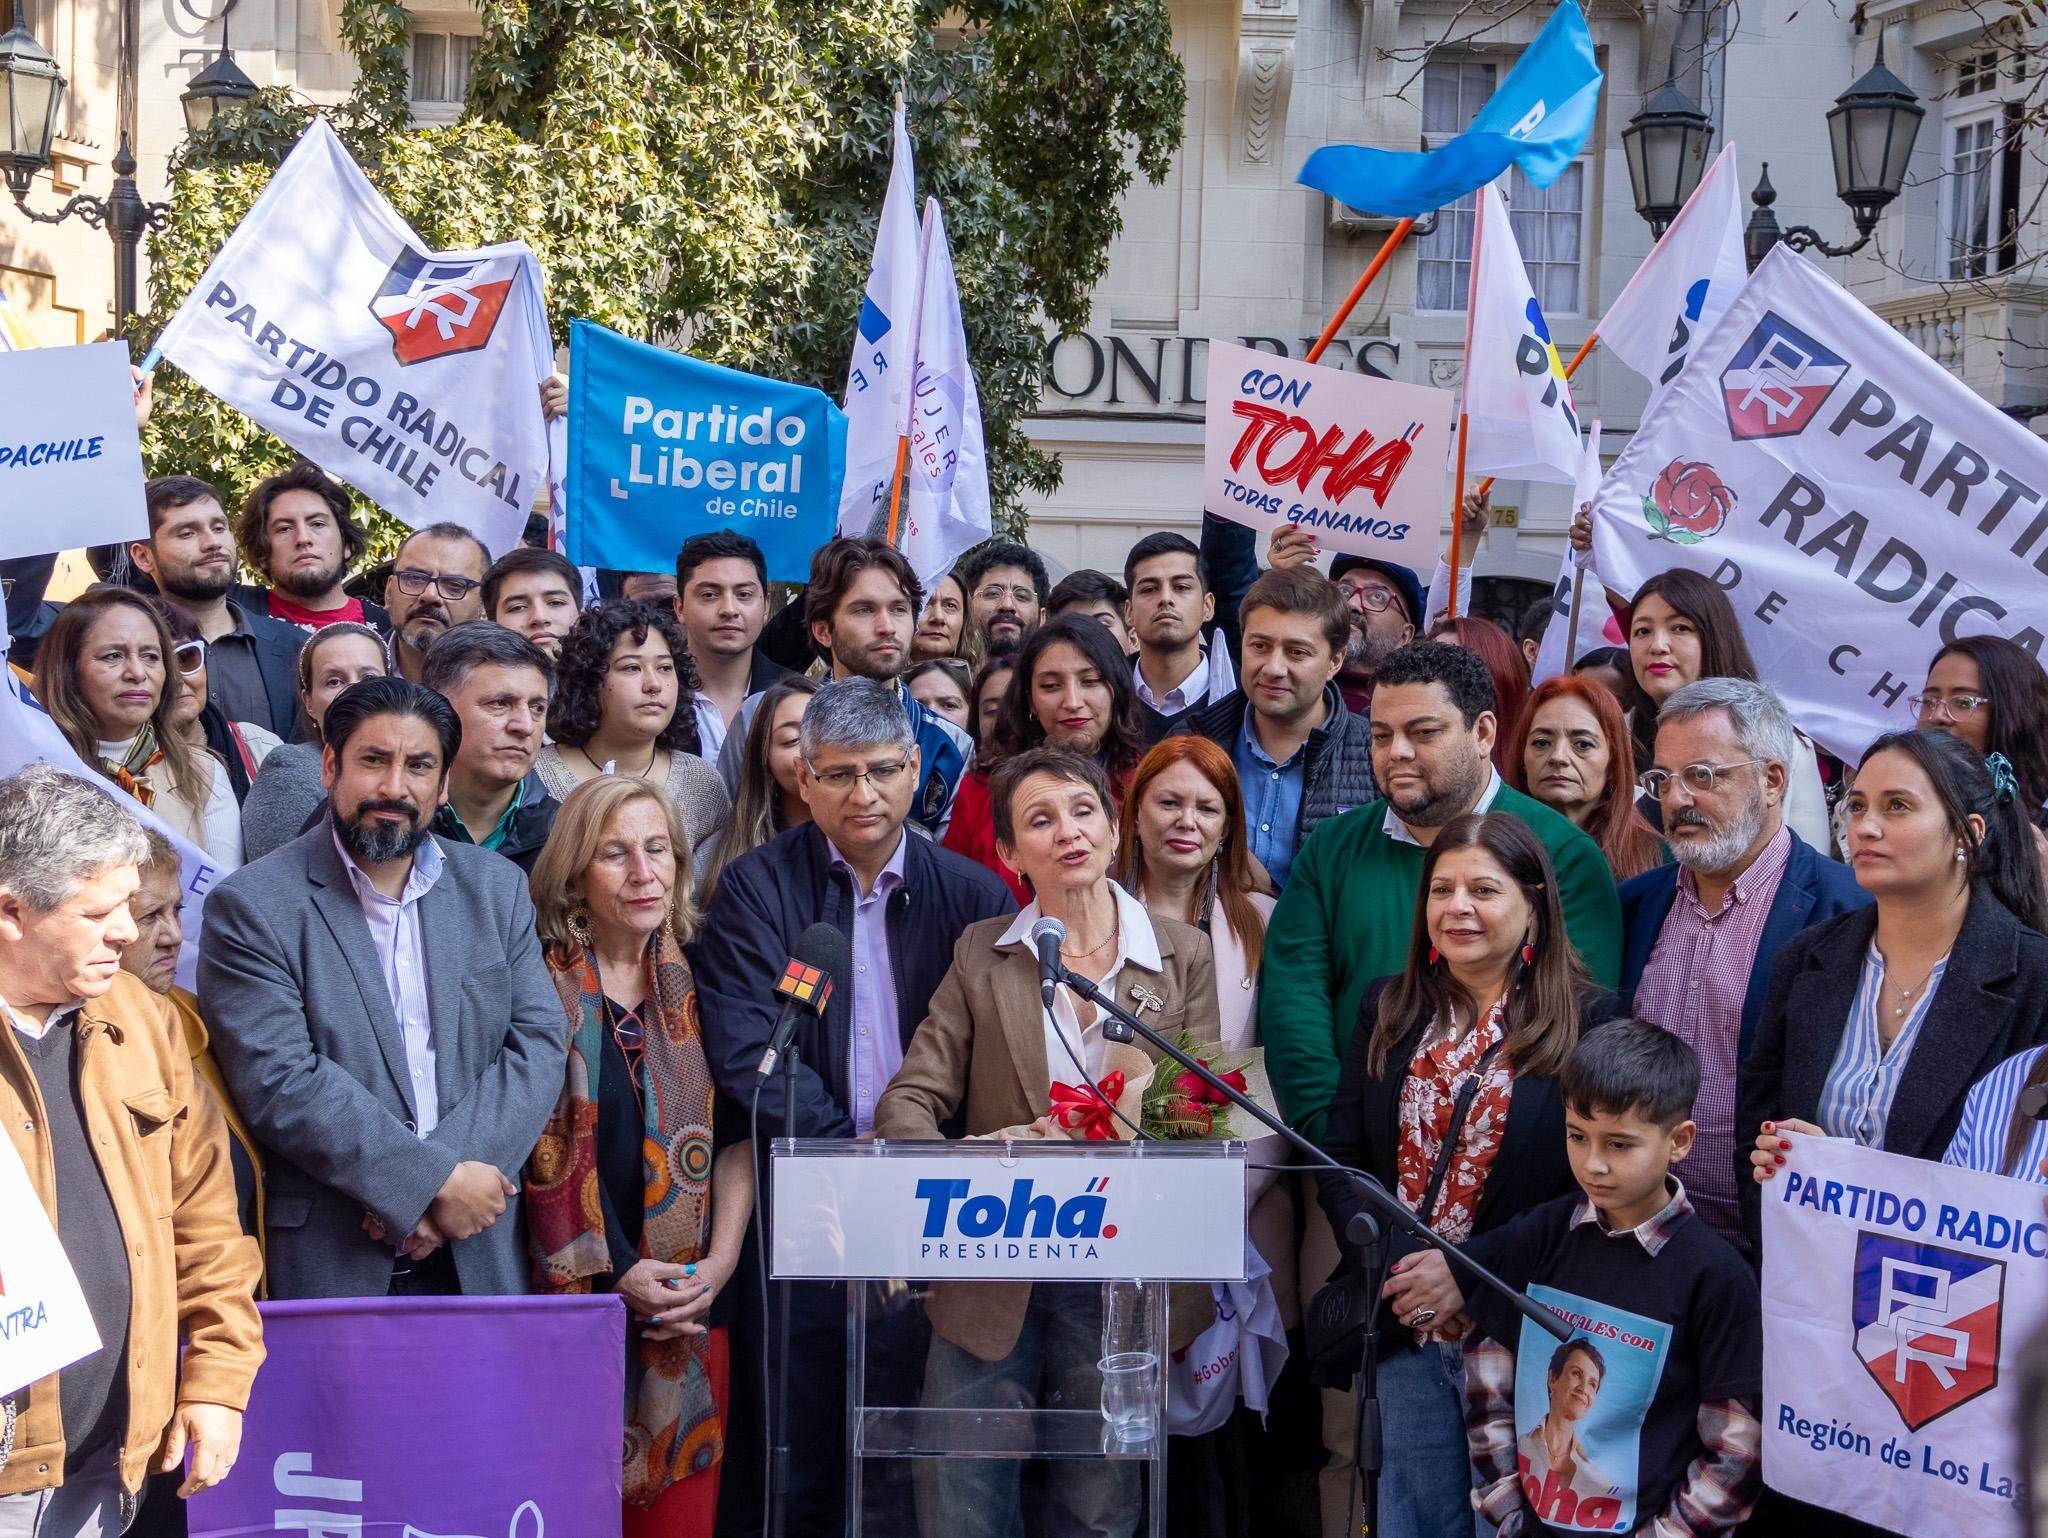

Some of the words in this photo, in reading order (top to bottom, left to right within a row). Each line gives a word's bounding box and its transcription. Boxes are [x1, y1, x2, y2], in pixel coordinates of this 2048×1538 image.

[205, 280, 381, 407] PARTIDO
[387, 391, 520, 511] RADICAL
[1241, 369, 1312, 409] CON
[270, 378, 335, 429] DE
[340, 415, 441, 498] CHILE
[623, 396, 806, 447] Partido
[629, 443, 802, 494] Liberal
[1230, 400, 1424, 509] TOHÁ
[1828, 380, 2048, 577] PARTI
[706, 497, 736, 516] de
[740, 498, 798, 519] Chile
[1223, 479, 1283, 514] TODAS
[1287, 503, 1411, 540] GANAMOS
[1494, 509, 1516, 524] 75
[1710, 557, 1789, 625] DE
[1828, 644, 1908, 708] CH
[1783, 1171, 1927, 1232] PARTIDO
[1935, 1204, 2048, 1260] RADIC
[921, 1243, 1099, 1259] PRESIDENTA
[1619, 1332, 1656, 1352] con
[1778, 1403, 1871, 1456] Región
[1880, 1437, 1911, 1469] de
[1922, 1445, 1970, 1485] Los
